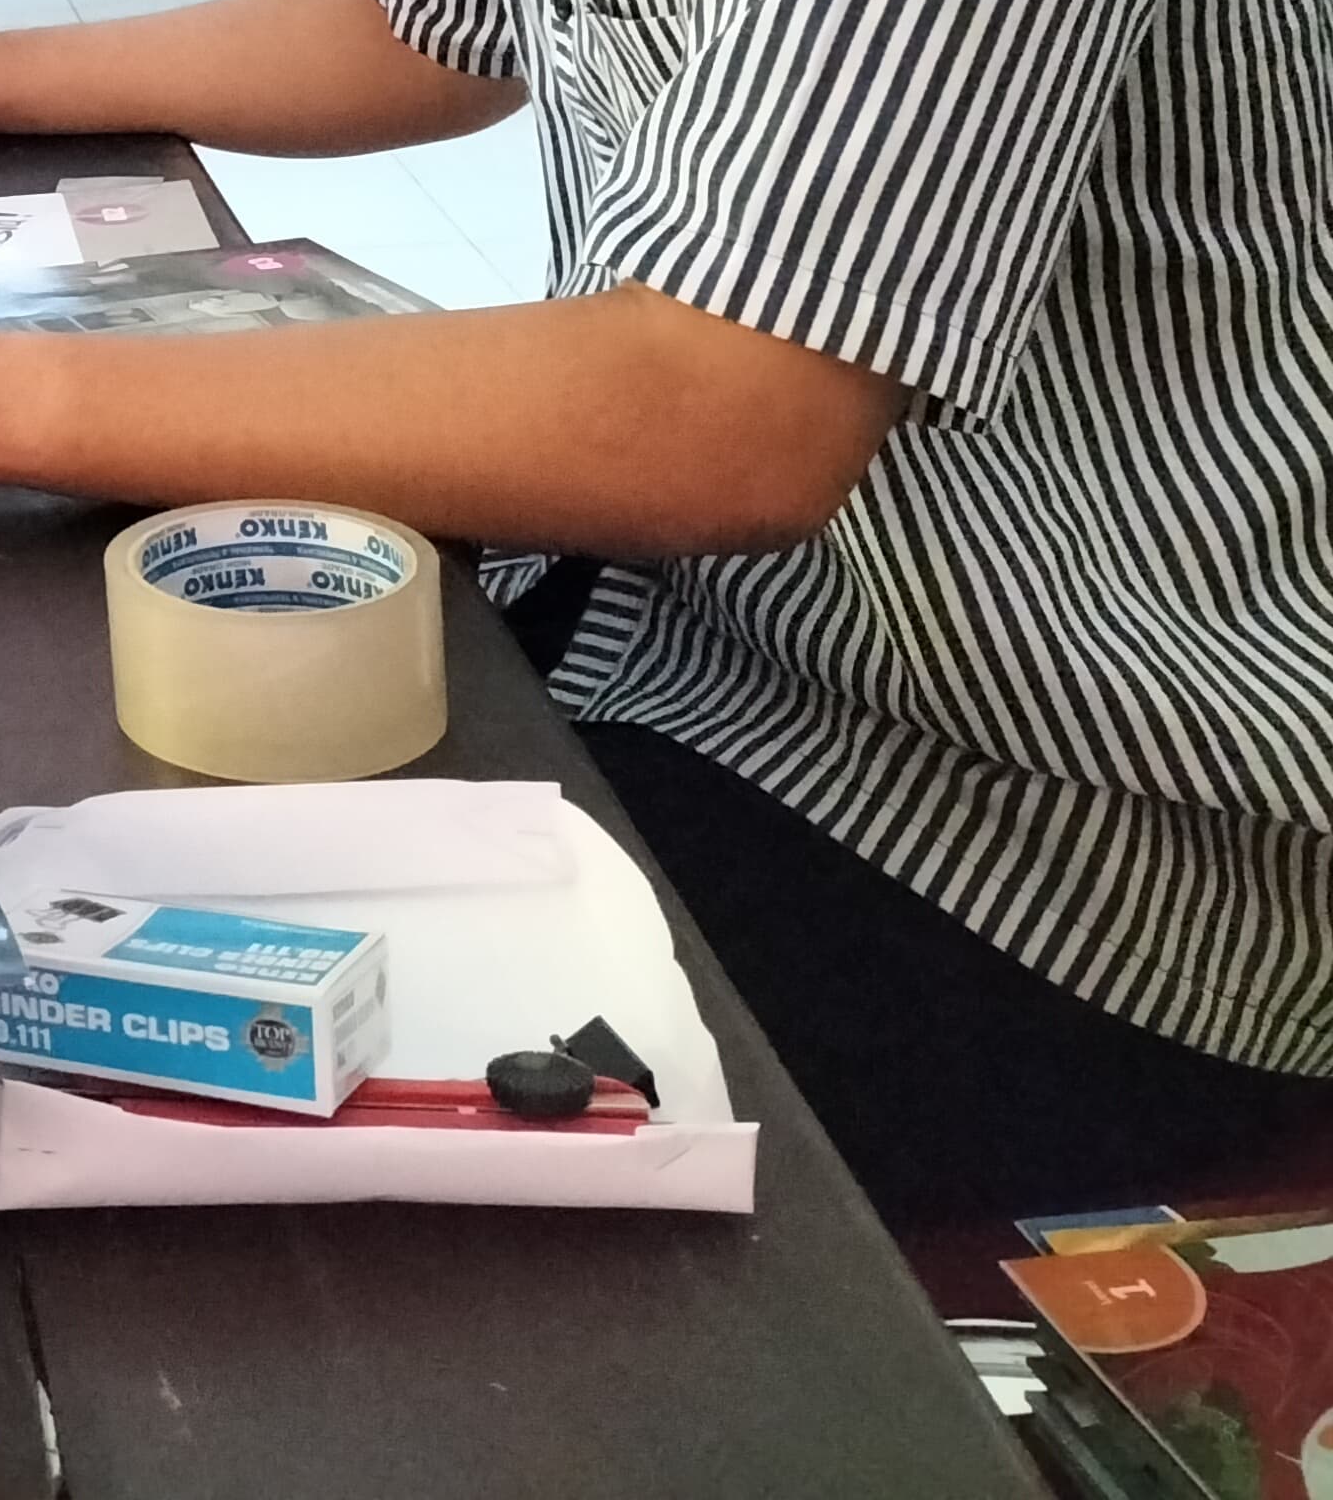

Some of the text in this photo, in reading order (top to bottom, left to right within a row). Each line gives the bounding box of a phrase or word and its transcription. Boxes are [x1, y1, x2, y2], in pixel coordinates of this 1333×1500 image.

[239, 518, 328, 541] KENKO
[183, 567, 266, 597] KENKO
[122, 1013, 230, 1052] CLIPS
[254, 1023, 293, 1043] TOP
